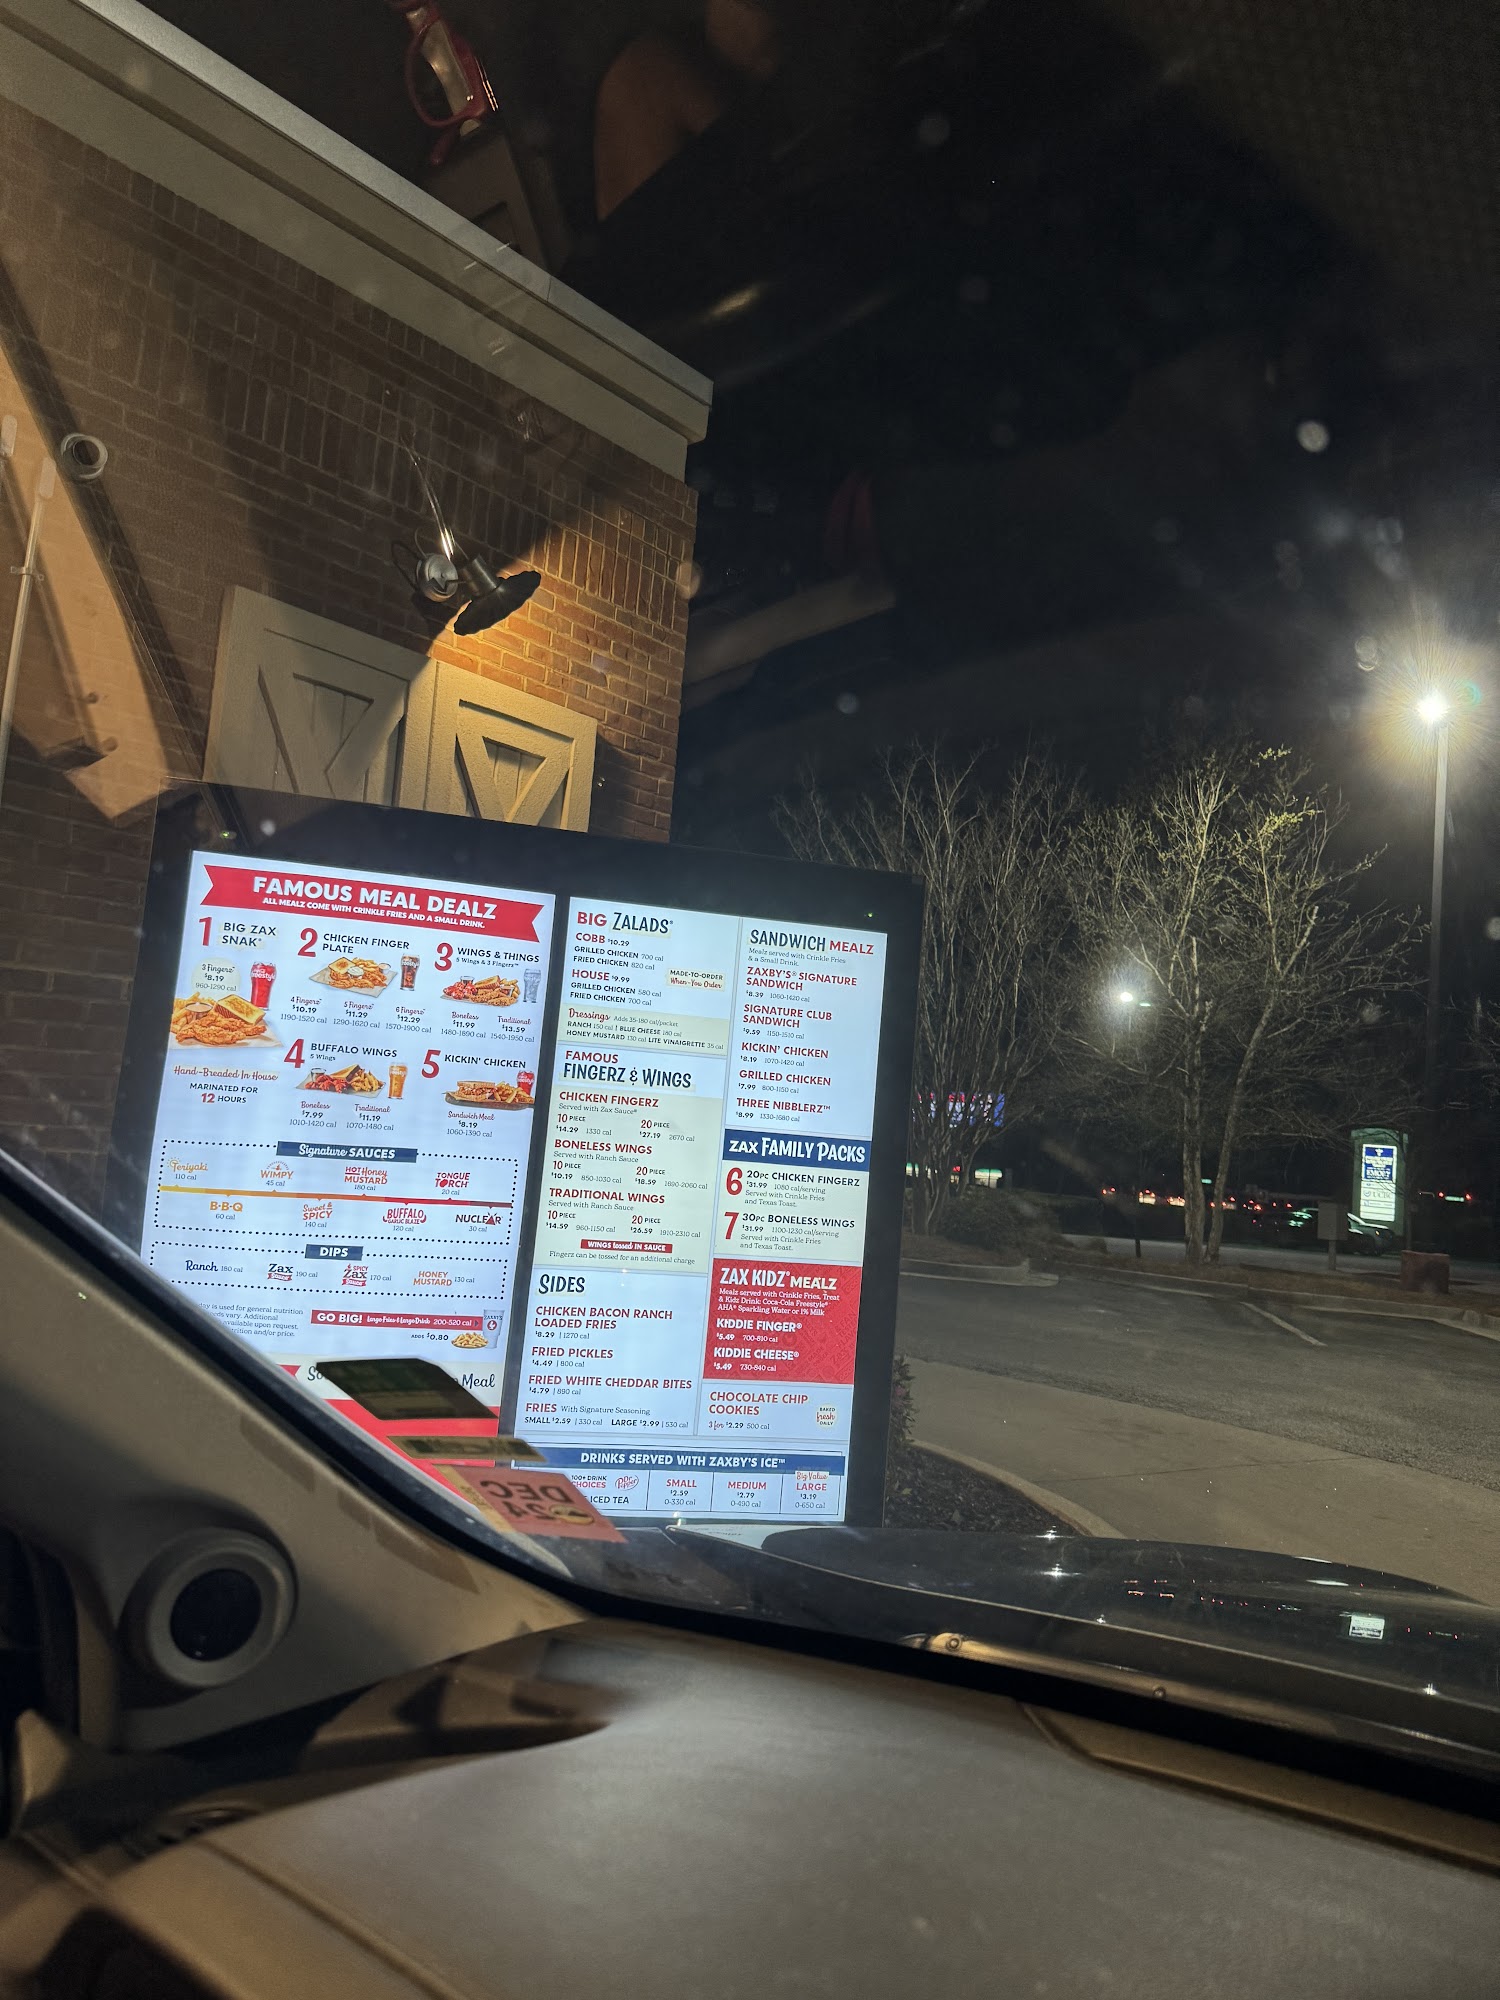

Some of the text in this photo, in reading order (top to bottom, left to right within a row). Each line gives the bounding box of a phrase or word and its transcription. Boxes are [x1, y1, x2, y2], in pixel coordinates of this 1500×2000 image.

[253, 876, 498, 919] FAMOUS MEAL DEALZ
[279, 899, 305, 908] MEALZ
[307, 902, 330, 910] COME
[332, 904, 351, 912] WITH
[352, 906, 385, 916] CRINKLE
[386, 910, 407, 919] FRIES
[408, 912, 425, 921] AND
[434, 916, 458, 925] SMALL
[460, 919, 485, 928] DRINK.
[577, 912, 607, 927] BIG
[199, 917, 212, 946] 1
[223, 922, 276, 936] BIG ZAX
[298, 928, 318, 957] 2
[323, 933, 410, 949] CHICKEN FINGER
[576, 932, 630, 946] COBB $10.29
[750, 929, 874, 955] SANDWICH MEALZ
[323, 944, 354, 953] PLATE
[457, 947, 540, 962] WINGS & THINGS
[574, 946, 639, 958] GRILLED CHICKEN
[434, 942, 453, 971] 3
[597, 958, 628, 967] CHICKEN
[204, 973, 224, 982] $8.19
[572, 969, 610, 981] HOUSE
[670, 969, 723, 980] MADE-TO-ORDER
[799, 973, 857, 986] SIGNATURE
[746, 978, 803, 991] SANDWICH
[746, 990, 764, 998] $8.39
[397, 1014, 421, 1023] $12.29
[452, 1012, 479, 1020] Boneless
[568, 1008, 611, 1023] Dressings
[744, 1004, 832, 1020] SIGNATURE CLUB
[497, 1016, 531, 1025] Traditional
[743, 1015, 800, 1028] SANDWICH
[283, 1038, 305, 1068] 4
[311, 1043, 398, 1058] BUFFALO WINGS
[565, 1050, 619, 1063] FAMOUS
[741, 1042, 829, 1059] KICKIN' CHICKEN
[422, 1049, 441, 1078] 5
[444, 1054, 526, 1068] KICKIN' CHICKEN
[173, 1066, 278, 1080] Hand-Breaded In House
[563, 1063, 692, 1088] FINGERZ & WINGS
[739, 1070, 831, 1086] GRILLED CHICKEN
[189, 1082, 238, 1092] MARINATED
[201, 1093, 247, 1103] 12 HOURS
[559, 1091, 659, 1108] CHICKEN FINGERZ
[737, 1098, 770, 1109] THREE
[302, 1110, 323, 1118] $7.99
[448, 1111, 478, 1119] Sandwich
[556, 1125, 578, 1133] $14.29
[298, 1144, 395, 1158] Signature SAUCES
[554, 1139, 652, 1155] BONELESS WINGS
[729, 1137, 865, 1163] ZAX FAMILY PACKS
[362, 1167, 388, 1178] Honey
[344, 1176, 388, 1185] MUSTARD
[726, 1167, 743, 1195] 6
[747, 1181, 768, 1189] $31.99
[772, 1173, 860, 1187] CHICKEN FINGERZ
[549, 1188, 665, 1204] TRADITIONAL WINGS
[303, 1204, 325, 1212] Sweet
[303, 1211, 332, 1220] SPICY
[768, 1215, 855, 1228] BONELESS WINGS
[724, 1212, 739, 1240] 7
[320, 1246, 348, 1258] DIPS
[186, 1260, 218, 1272] Ranch
[268, 1264, 293, 1273] Zax
[413, 1278, 452, 1286] MUSTARD
[538, 1274, 585, 1294] SIDES
[720, 1267, 749, 1285] ZAX
[790, 1276, 837, 1290] MEALZ
[317, 1313, 335, 1322] GO
[338, 1314, 362, 1323] BIG!
[536, 1306, 673, 1320] CHICKEN BACON RANCH
[534, 1318, 617, 1329] LOADED FRIES
[716, 1318, 753, 1329] KIDDIE
[532, 1347, 613, 1359] FRIED PICKLES
[714, 1347, 751, 1358] KIDDIE
[462, 1374, 495, 1389] Meal
[528, 1375, 692, 1389] FRIED WHITE CHEDDAR BITES
[710, 1392, 808, 1404] CHOCOLATE CHIP
[526, 1403, 557, 1413] FRIES
[708, 1404, 759, 1415] COOKIES
[816, 1412, 835, 1422] fresh
[581, 1452, 625, 1464] DRINKS
[628, 1454, 673, 1464] SERVED
[677, 1456, 706, 1466] WITH
[709, 1457, 758, 1467] ZAXBY'S
[666, 1479, 697, 1488] SMALL
[728, 1482, 766, 1490] MEDIUM
[613, 1496, 629, 1504] TEA
